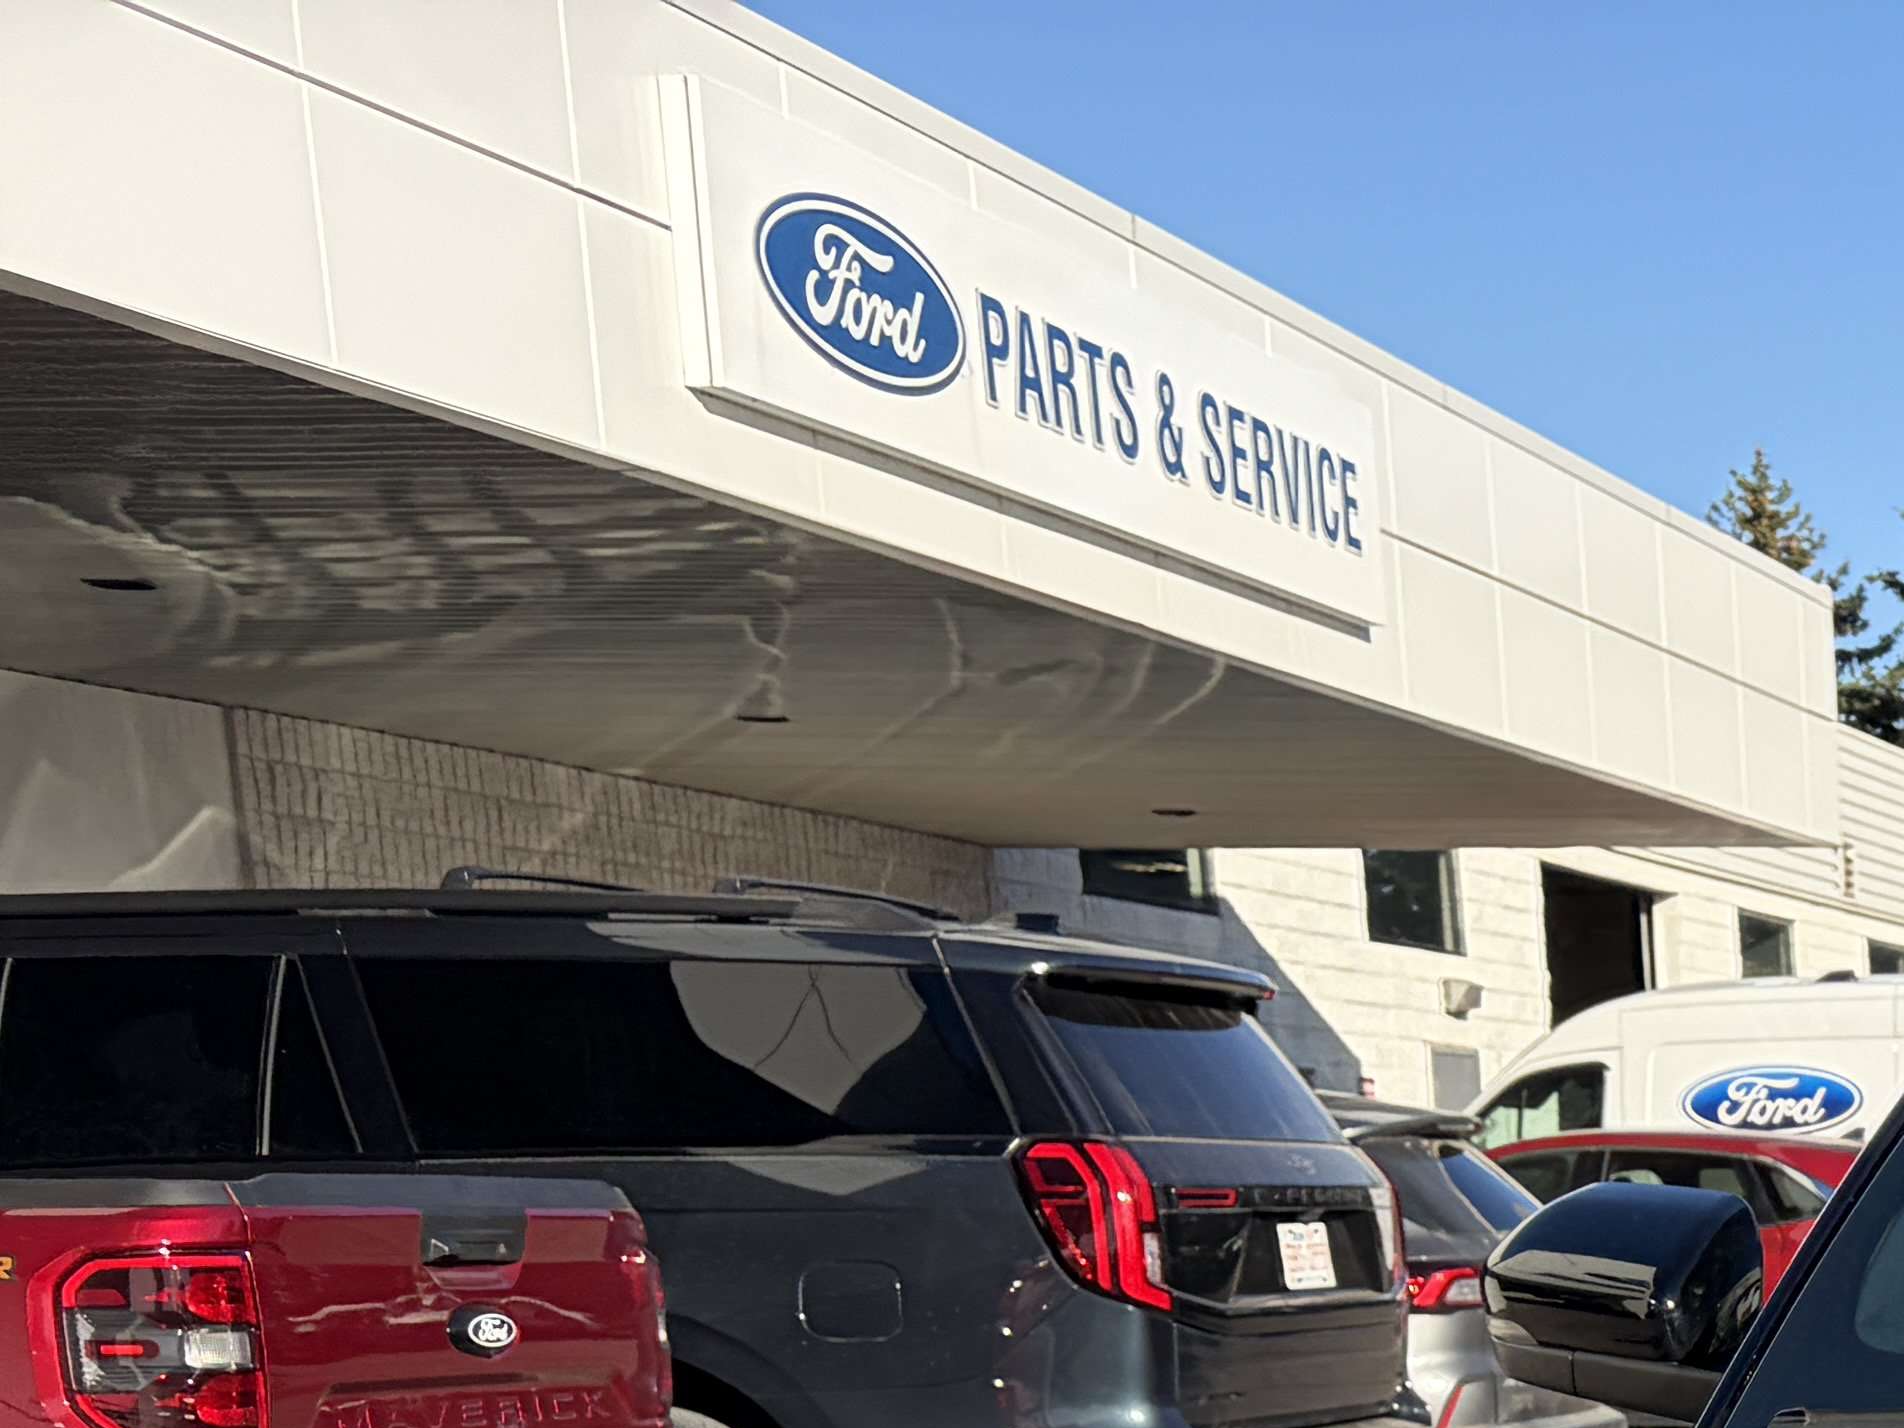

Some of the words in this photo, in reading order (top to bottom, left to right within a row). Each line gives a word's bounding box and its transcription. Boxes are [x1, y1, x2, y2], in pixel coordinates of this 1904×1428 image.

[805, 224, 926, 363] Ford
[976, 288, 1139, 463] PARTS
[1155, 370, 1189, 482] &
[1200, 391, 1362, 554] SERVICE
[1717, 1076, 1826, 1126] Ford
